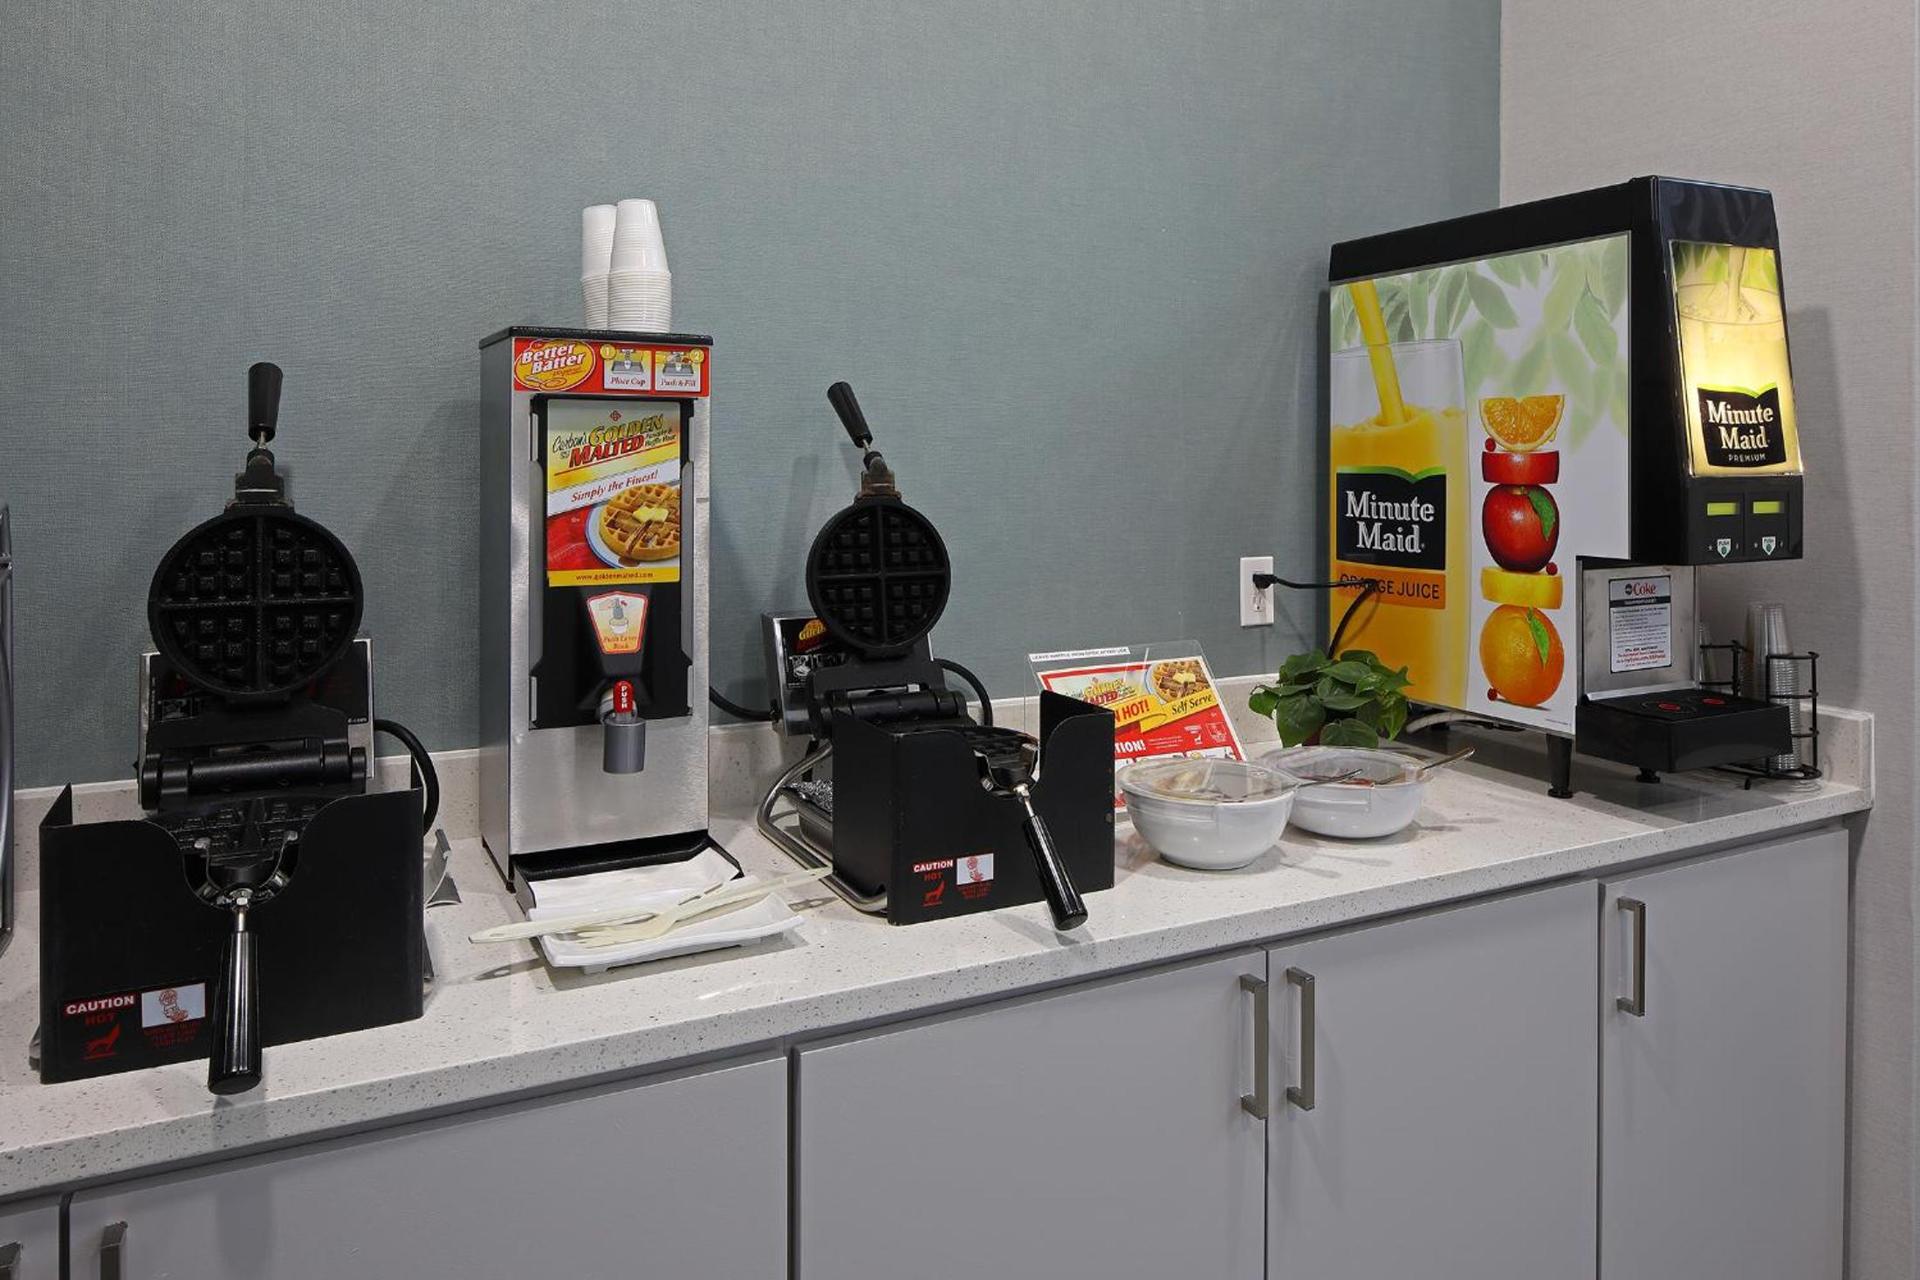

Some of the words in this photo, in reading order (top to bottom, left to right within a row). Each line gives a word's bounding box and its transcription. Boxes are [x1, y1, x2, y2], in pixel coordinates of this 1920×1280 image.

[521, 343, 576, 365] Better
[532, 353, 585, 374] Batter
[631, 377, 646, 387] Cup
[1706, 400, 1774, 425] Minute
[588, 413, 664, 447] GOLDEN
[1719, 426, 1769, 450] Maid
[568, 434, 645, 468] MALTED
[1728, 453, 1767, 463] PREMIUM
[571, 485, 606, 502] Simply
[608, 480, 624, 492] the
[626, 469, 659, 485] Finest!
[1345, 490, 1435, 522] Minute
[1356, 521, 1422, 554] Maid
[1397, 581, 1440, 600] JUICE
[1633, 582, 1656, 596] Coke
[1122, 699, 1150, 720] HOT!
[1171, 702, 1188, 715] Self
[1189, 695, 1213, 709] Serve
[913, 859, 954, 873] CAUTION
[66, 995, 135, 1015] CAUTION
